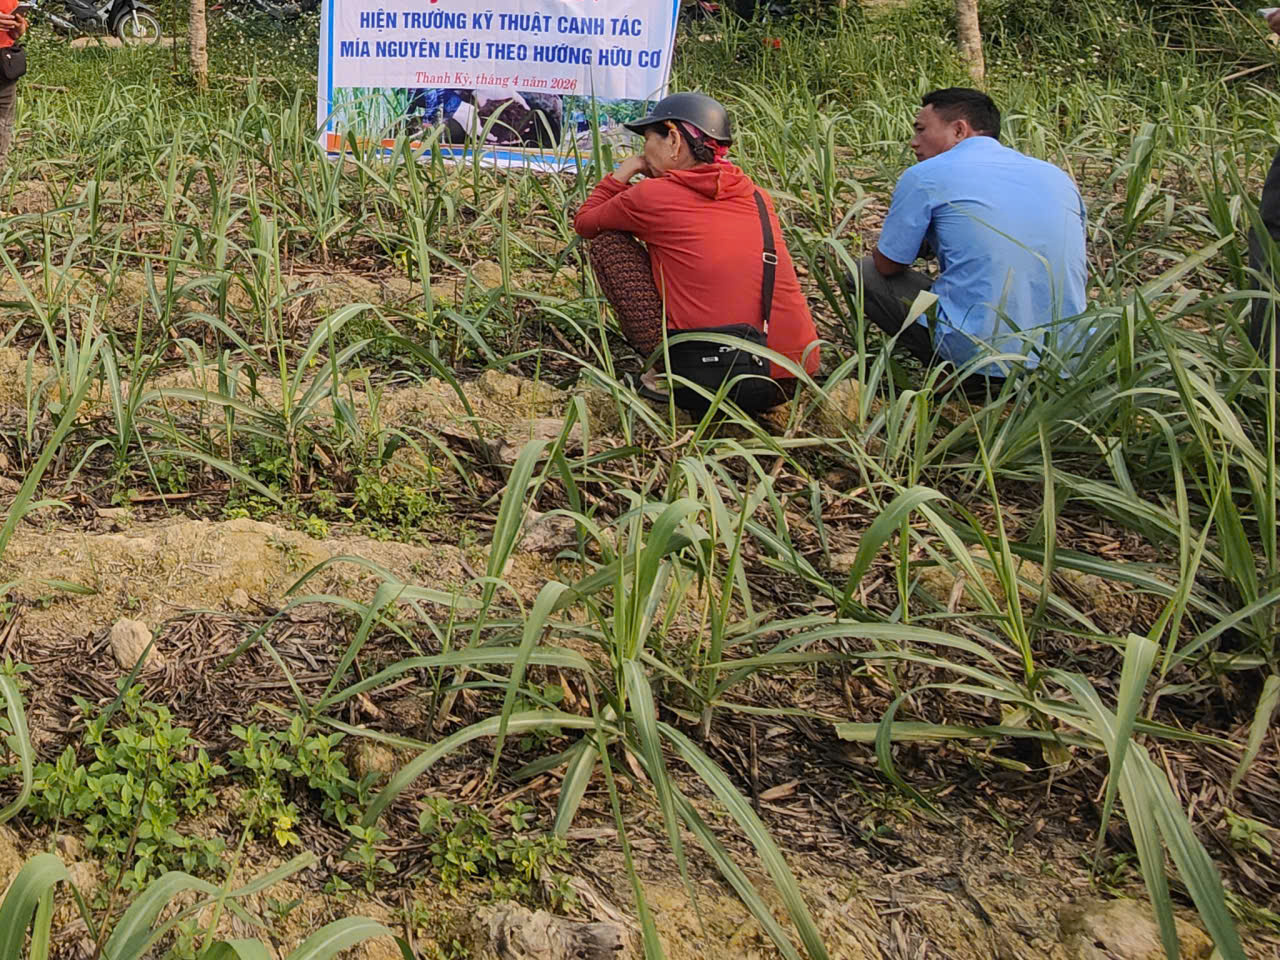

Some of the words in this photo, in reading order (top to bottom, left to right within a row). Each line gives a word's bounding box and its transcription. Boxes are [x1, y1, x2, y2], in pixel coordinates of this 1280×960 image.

[360, 8, 397, 32] HIỆN
[402, 8, 467, 30] TRƯỜNG
[472, 10, 494, 30] KỸ
[499, 11, 552, 36] THUẬT
[557, 16, 605, 35] CANH
[610, 15, 642, 36] TÁC
[340, 37, 370, 58] MÍA
[376, 37, 440, 58] NGUYÊN
[445, 38, 480, 62] LIỆU
[486, 43, 527, 61] THEO
[533, 43, 593, 65] HƯỚNG
[598, 45, 632, 67] HỮU
[638, 48, 662, 68] CƠ
[415, 71, 451, 84] Thanh
[476, 73, 510, 88] tháng
[512, 74, 519, 86] 4
[522, 76, 547, 89] năm
[551, 78, 577, 90] 2026
